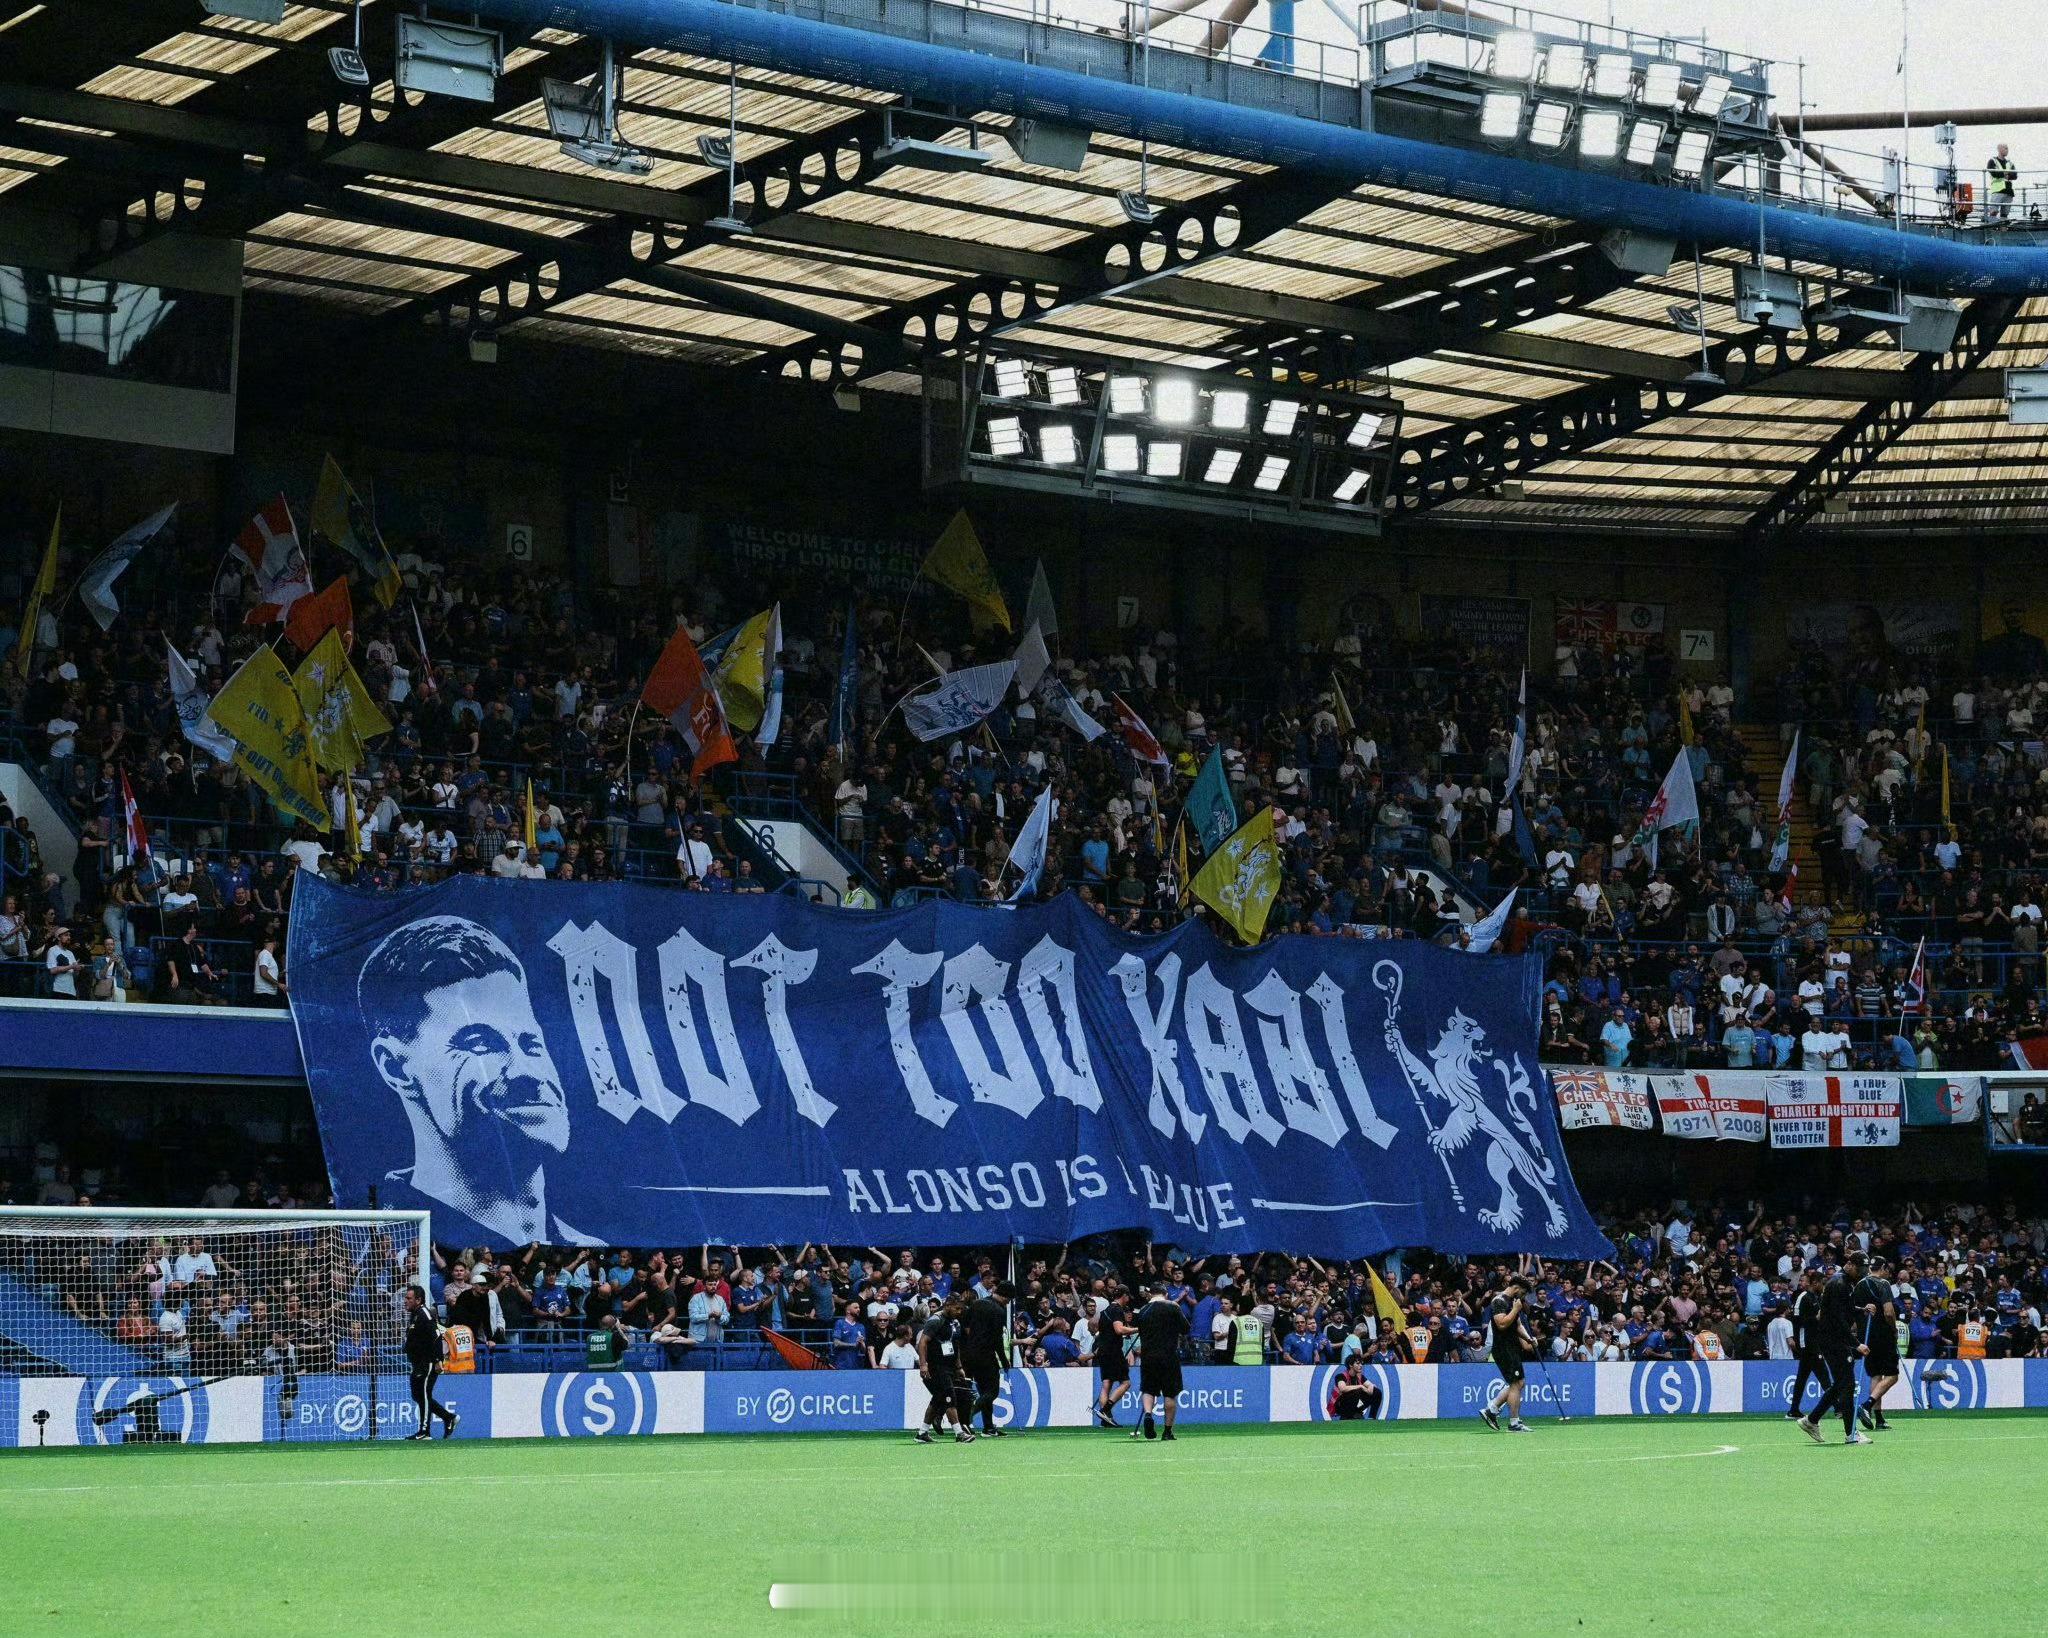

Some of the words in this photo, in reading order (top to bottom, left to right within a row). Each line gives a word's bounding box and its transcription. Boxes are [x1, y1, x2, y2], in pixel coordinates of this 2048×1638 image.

[511, 529, 527, 556] 6
[726, 523, 832, 550] WELCOME
[841, 538, 867, 554] TO
[731, 540, 789, 562] FIRST
[798, 550, 881, 572] LONDON
[1122, 601, 1135, 624] 7
[751, 824, 775, 852] 6
[545, 919, 838, 1128] NOT
[849, 937, 1104, 1130] TOO
[1854, 1079, 1860, 1089] A
[1863, 1078, 1887, 1089] TRUE
[1563, 1089, 1627, 1105] CHELSEA
[1630, 1093, 1646, 1105] FC
[1859, 1090, 1882, 1100] BLUE
[1574, 1102, 1594, 1111] JON
[1624, 1105, 1644, 1114] OVER
[1684, 1098, 1709, 1111] TIM
[1773, 1105, 1817, 1119] CHARLIE
[1819, 1104, 1875, 1117] NAUGHTON
[1877, 1104, 1896, 1117] RIP
[1574, 1116, 1600, 1127] PETE
[1623, 1112, 1641, 1120] LAND
[1630, 1120, 1643, 1128] SEA
[1673, 1116, 1711, 1132] 1971
[1722, 1117, 1762, 1134] 2008
[1773, 1122, 1800, 1132] NEVER
[1802, 1121, 1813, 1132] TO
[1815, 1121, 1826, 1131] BE
[1775, 1133, 1825, 1145] FORGOTTEN
[842, 1160, 1045, 1213] ALONSO
[1056, 1154, 1108, 1209] IS
[1244, 1323, 1258, 1331] 691
[455, 1335, 471, 1345] 093
[590, 1334, 606, 1342] PRESS
[1413, 1335, 1427, 1343] 041
[1463, 1386, 1482, 1403] BY
[1520, 1384, 1571, 1402] IRCLE
[1761, 1382, 1778, 1398] BY
[737, 1397, 757, 1416] BY
[800, 1395, 874, 1416] CIRCLE
[1121, 1391, 1142, 1409] BY
[1177, 1389, 1243, 1409] CIRCLE
[300, 1403, 328, 1424] BY
[375, 1401, 457, 1424] CIRE
